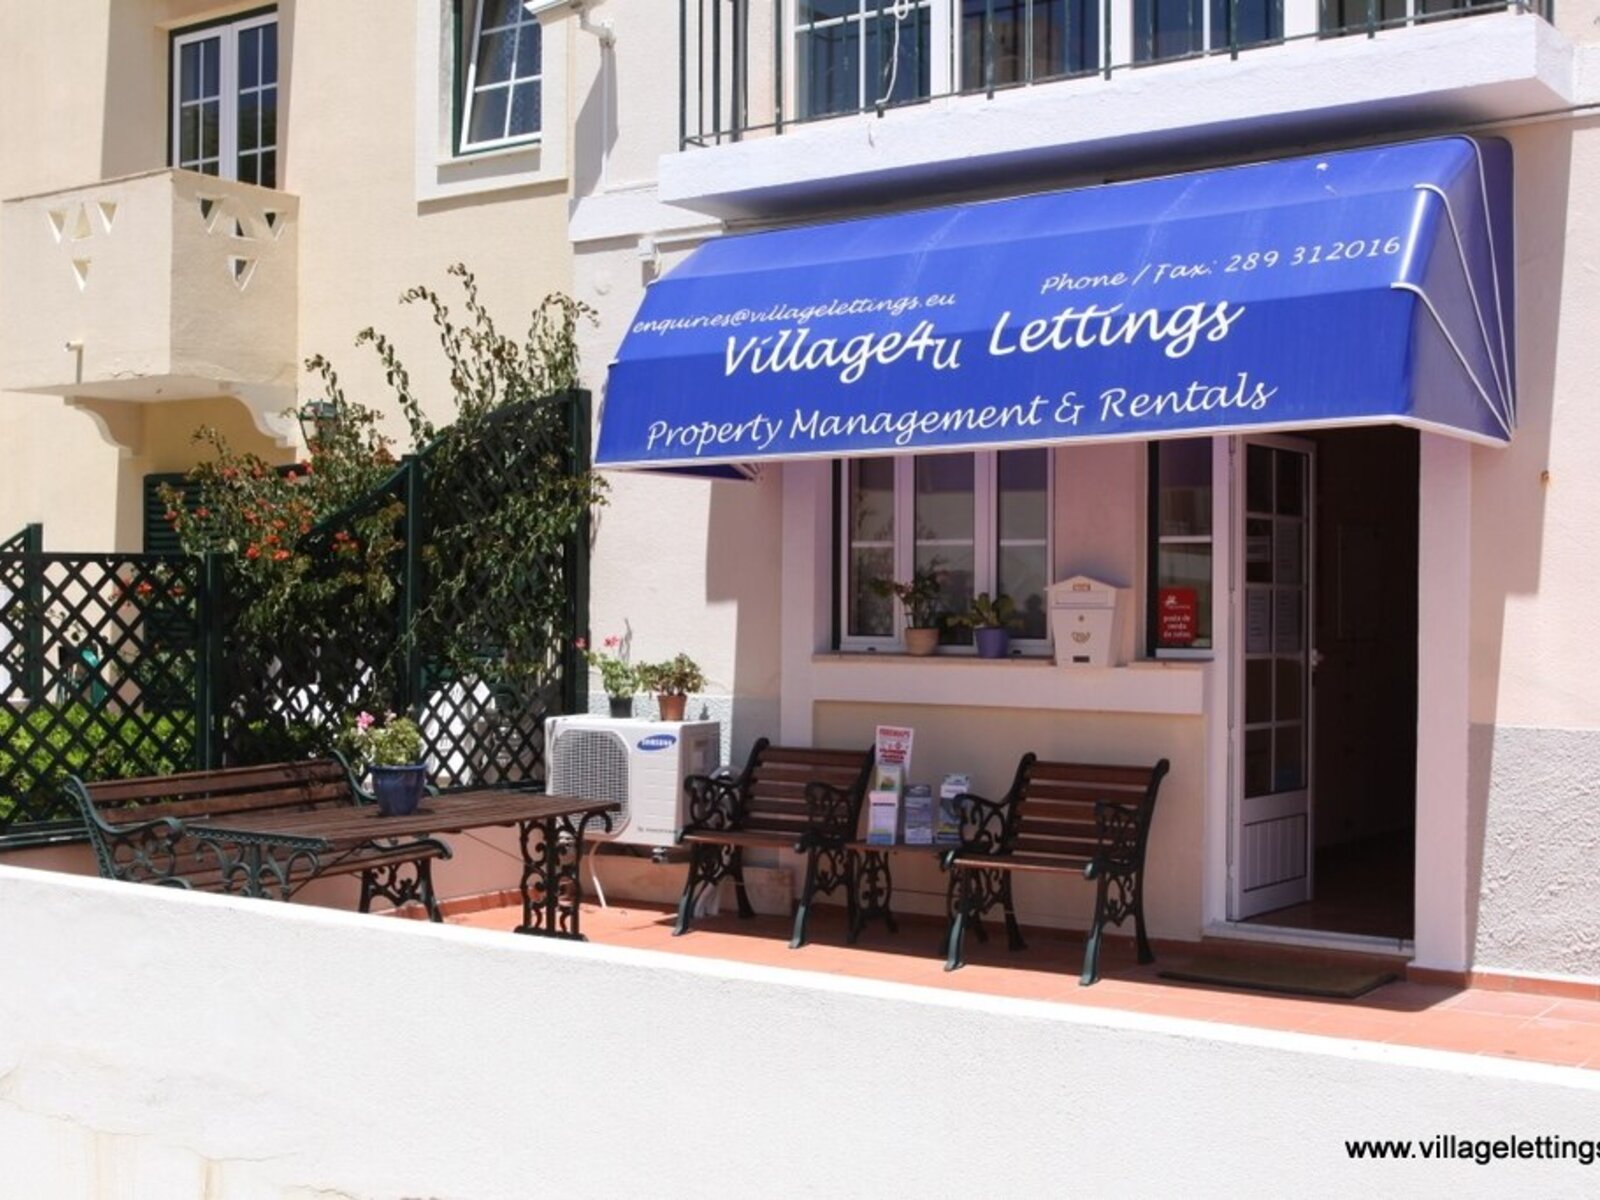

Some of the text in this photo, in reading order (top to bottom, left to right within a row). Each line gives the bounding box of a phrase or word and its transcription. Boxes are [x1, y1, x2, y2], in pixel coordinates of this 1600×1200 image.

[1041, 270, 1127, 295] Phone
[1224, 250, 1280, 274] 289
[1291, 236, 1401, 265] 312016
[632, 292, 957, 335] enquiries@villagelettings.eu
[724, 299, 1245, 384] Village4u Lettings
[646, 371, 1279, 456] Property Management & Rentals
